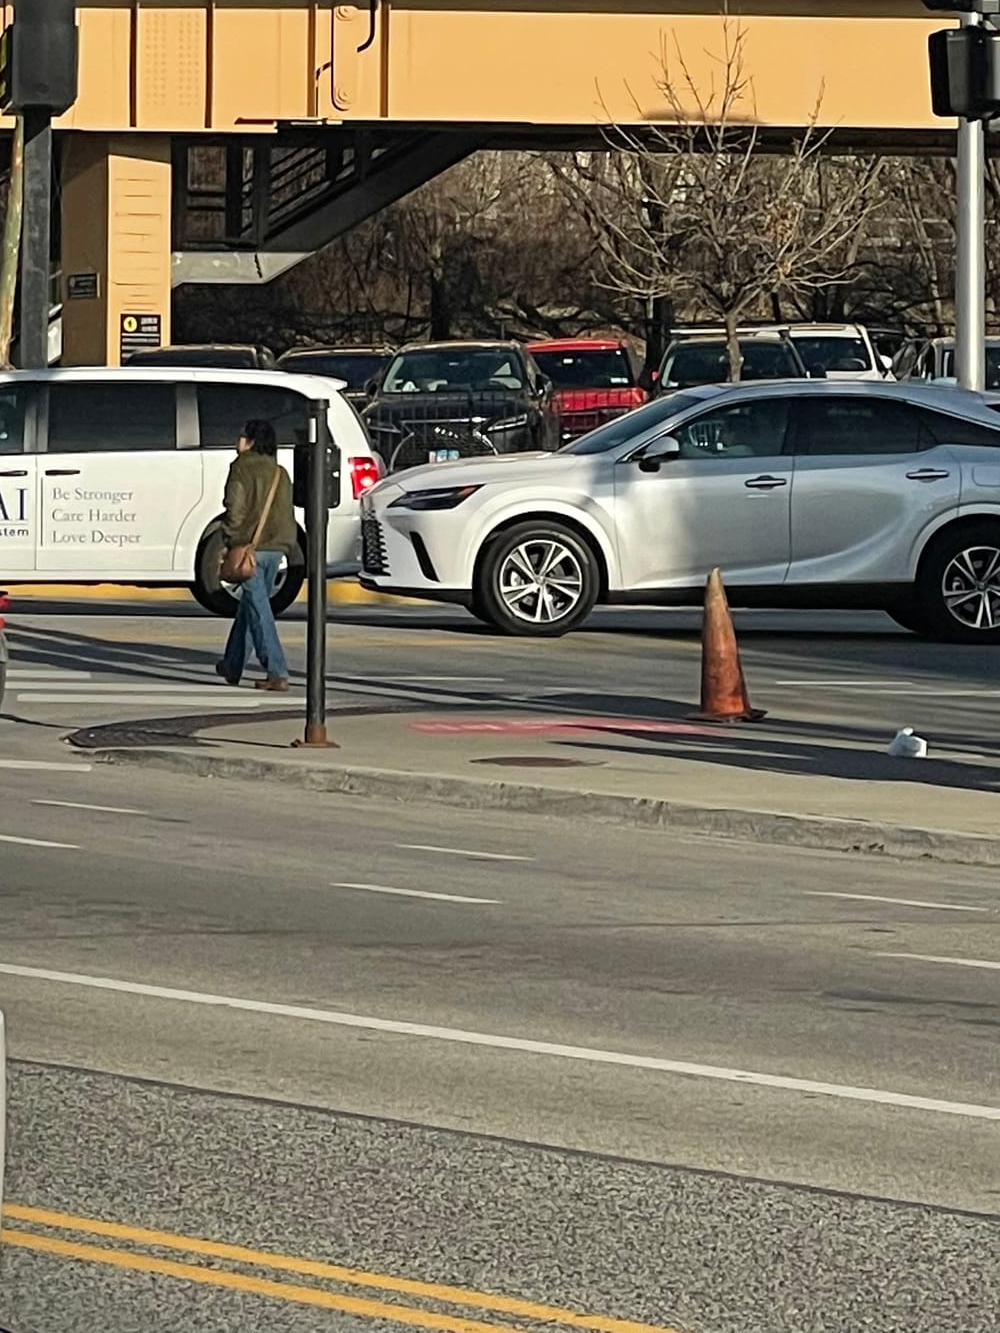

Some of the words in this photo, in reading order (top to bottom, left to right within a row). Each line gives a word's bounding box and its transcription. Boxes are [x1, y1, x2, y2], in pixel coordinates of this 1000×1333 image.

[52, 487, 70, 501] Be
[75, 487, 134, 505] Stronger
[51, 509, 84, 523] Care
[88, 509, 137, 523] Harder
[52, 530, 86, 544] Love
[90, 530, 142, 548] Deeper
